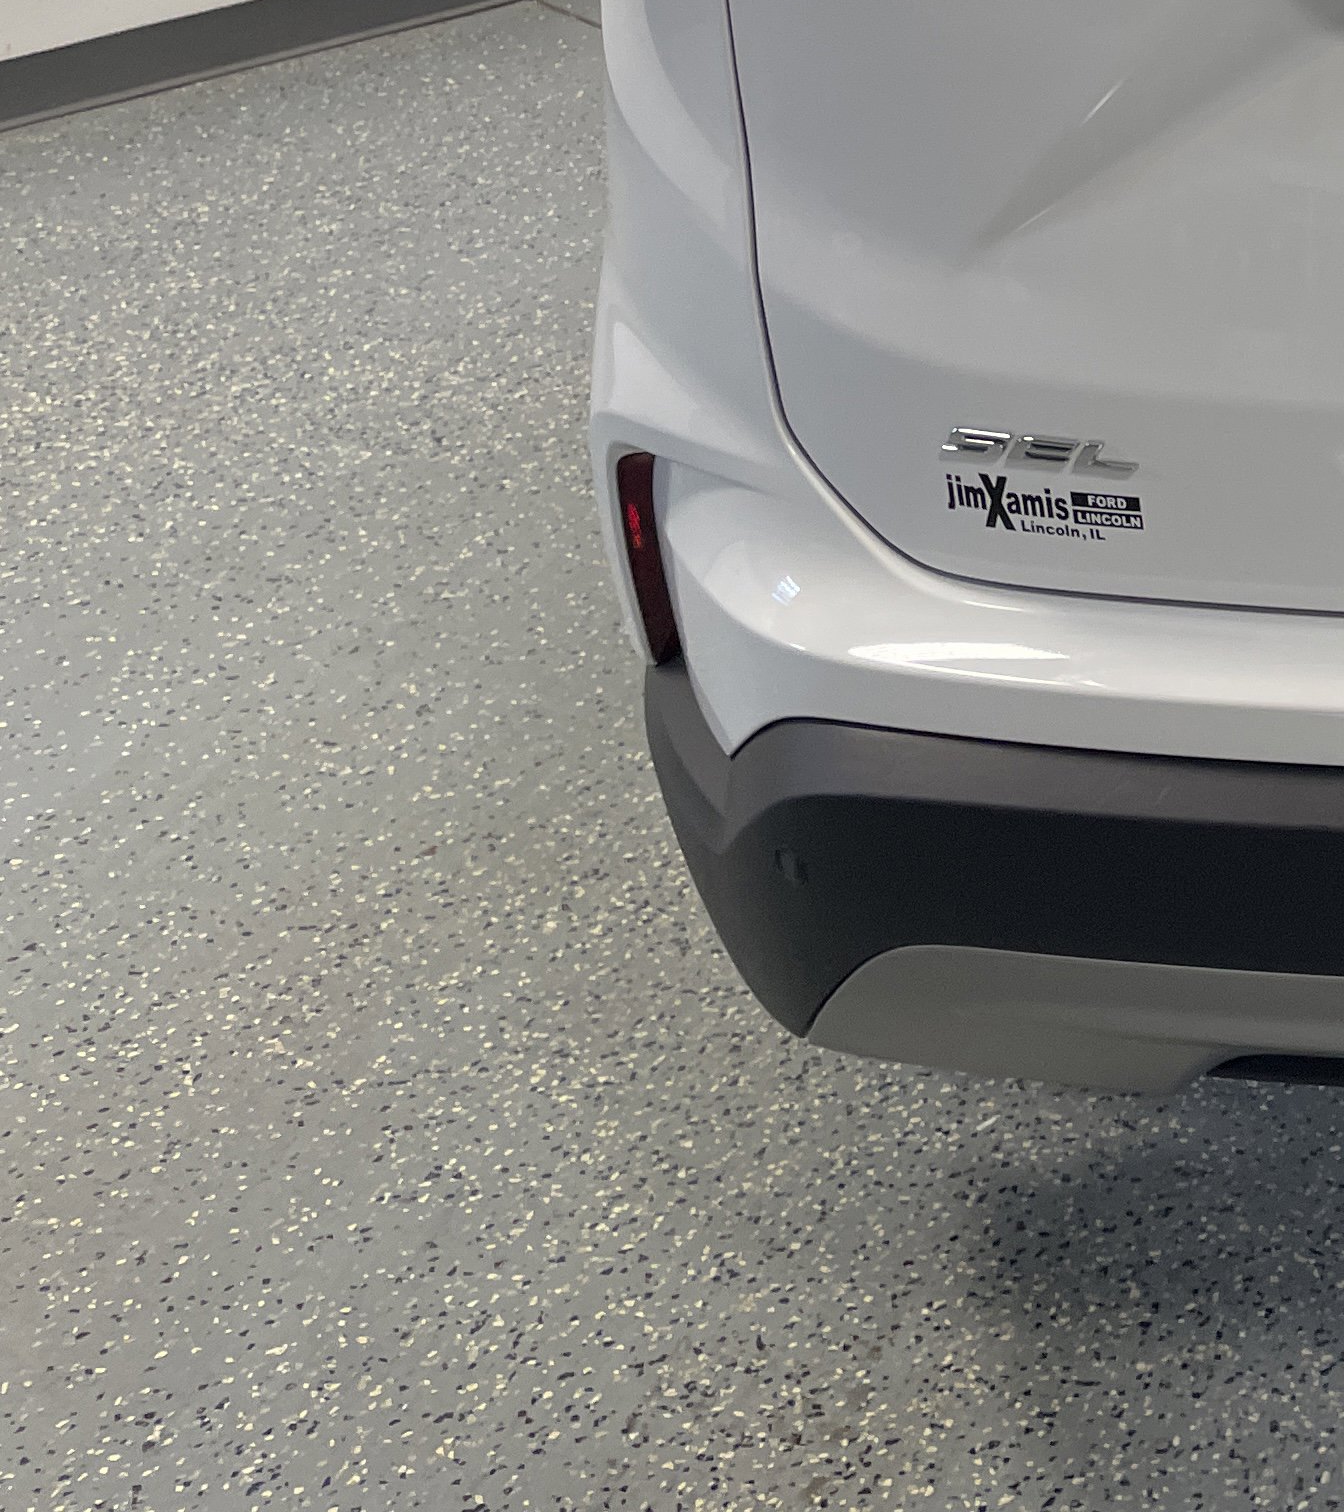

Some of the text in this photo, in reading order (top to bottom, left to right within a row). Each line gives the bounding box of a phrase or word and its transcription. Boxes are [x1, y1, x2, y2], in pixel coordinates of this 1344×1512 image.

[938, 426, 1140, 480] SEL
[1087, 495, 1128, 510] FORD
[1076, 511, 1142, 528] LINCOLN
[1020, 519, 1106, 541] Lincoln, IL
